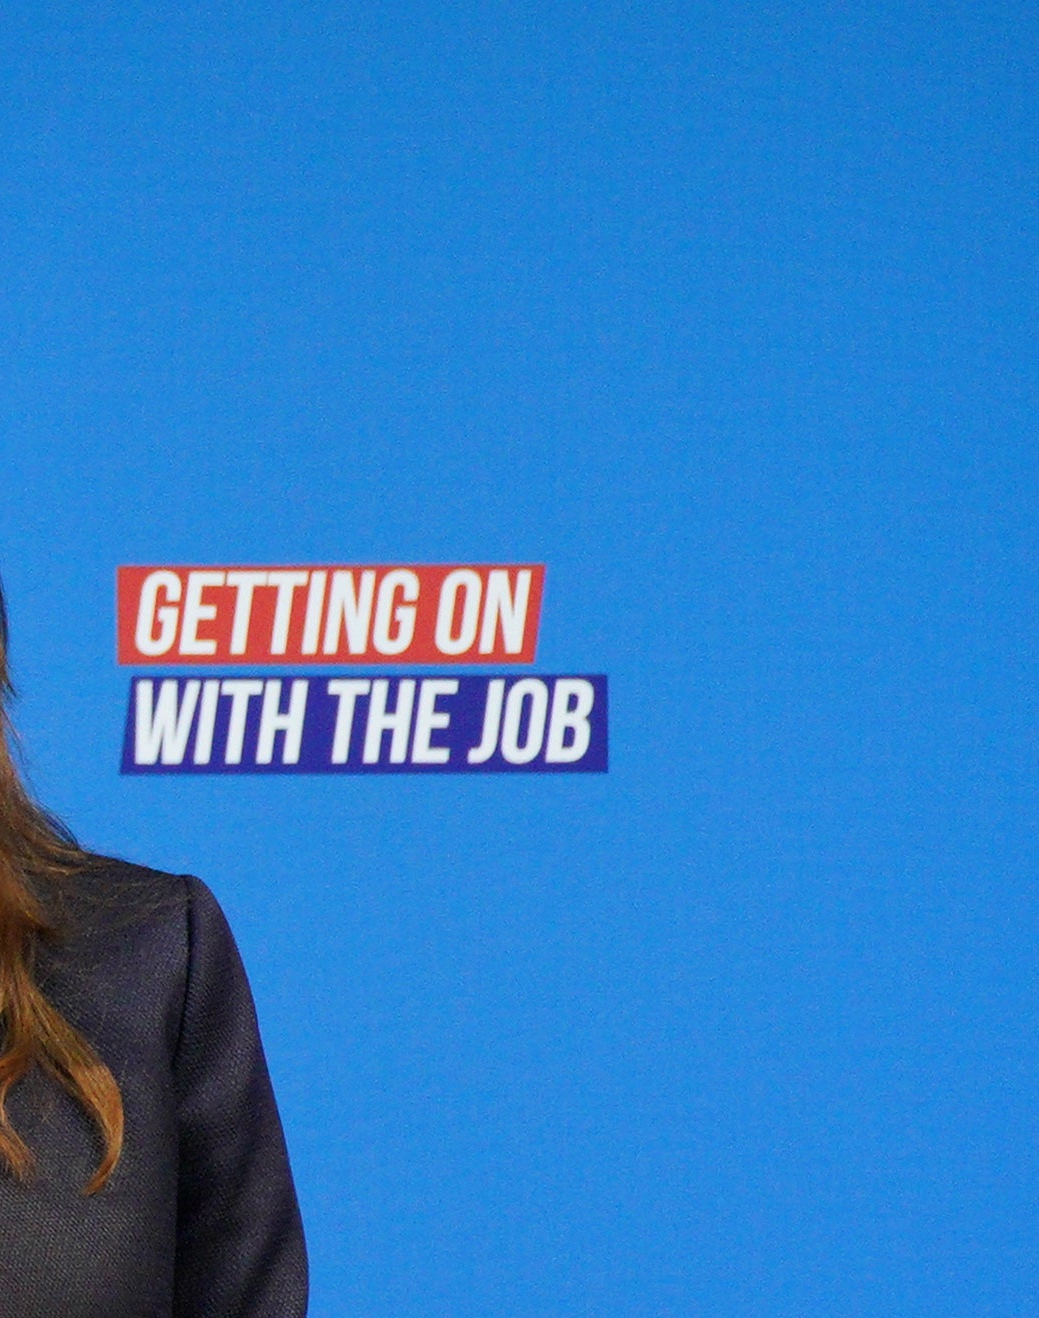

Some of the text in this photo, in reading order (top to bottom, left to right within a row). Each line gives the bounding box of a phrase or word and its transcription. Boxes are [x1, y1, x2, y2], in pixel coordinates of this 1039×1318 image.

[134, 569, 532, 656] GETTING ON
[134, 677, 595, 766] WITH THE JOB
